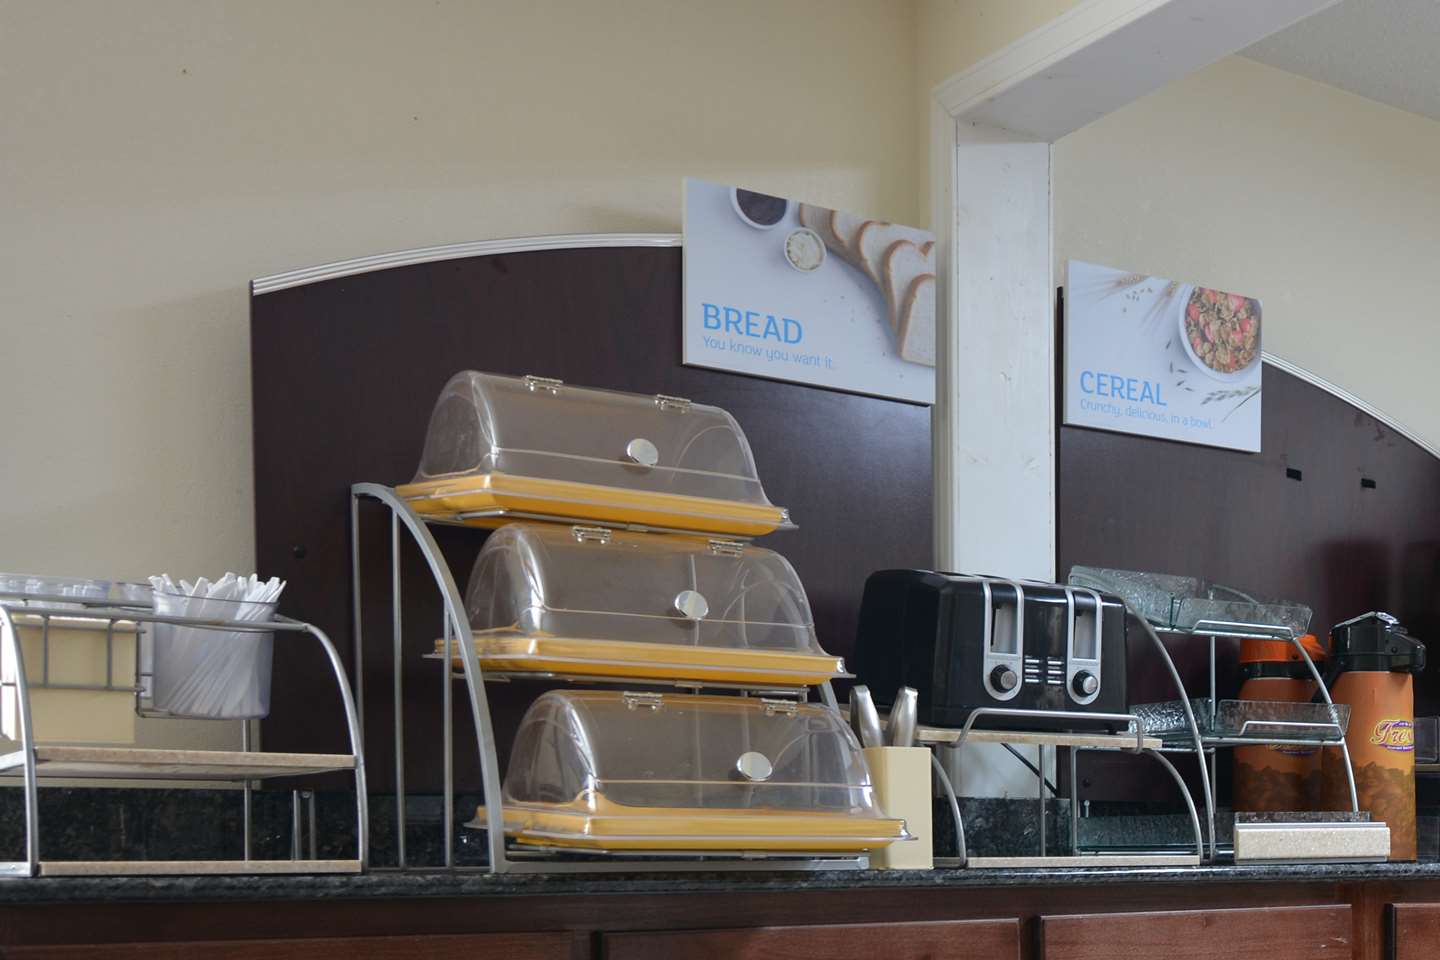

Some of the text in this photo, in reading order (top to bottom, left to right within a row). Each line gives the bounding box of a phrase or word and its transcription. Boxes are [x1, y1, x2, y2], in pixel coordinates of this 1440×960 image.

[702, 303, 803, 345] BREAD
[703, 336, 726, 350] You
[730, 340, 762, 357] know
[766, 347, 788, 362] you
[792, 352, 821, 366] want
[1080, 371, 1168, 406] CEREAL
[1171, 413, 1180, 423] in
